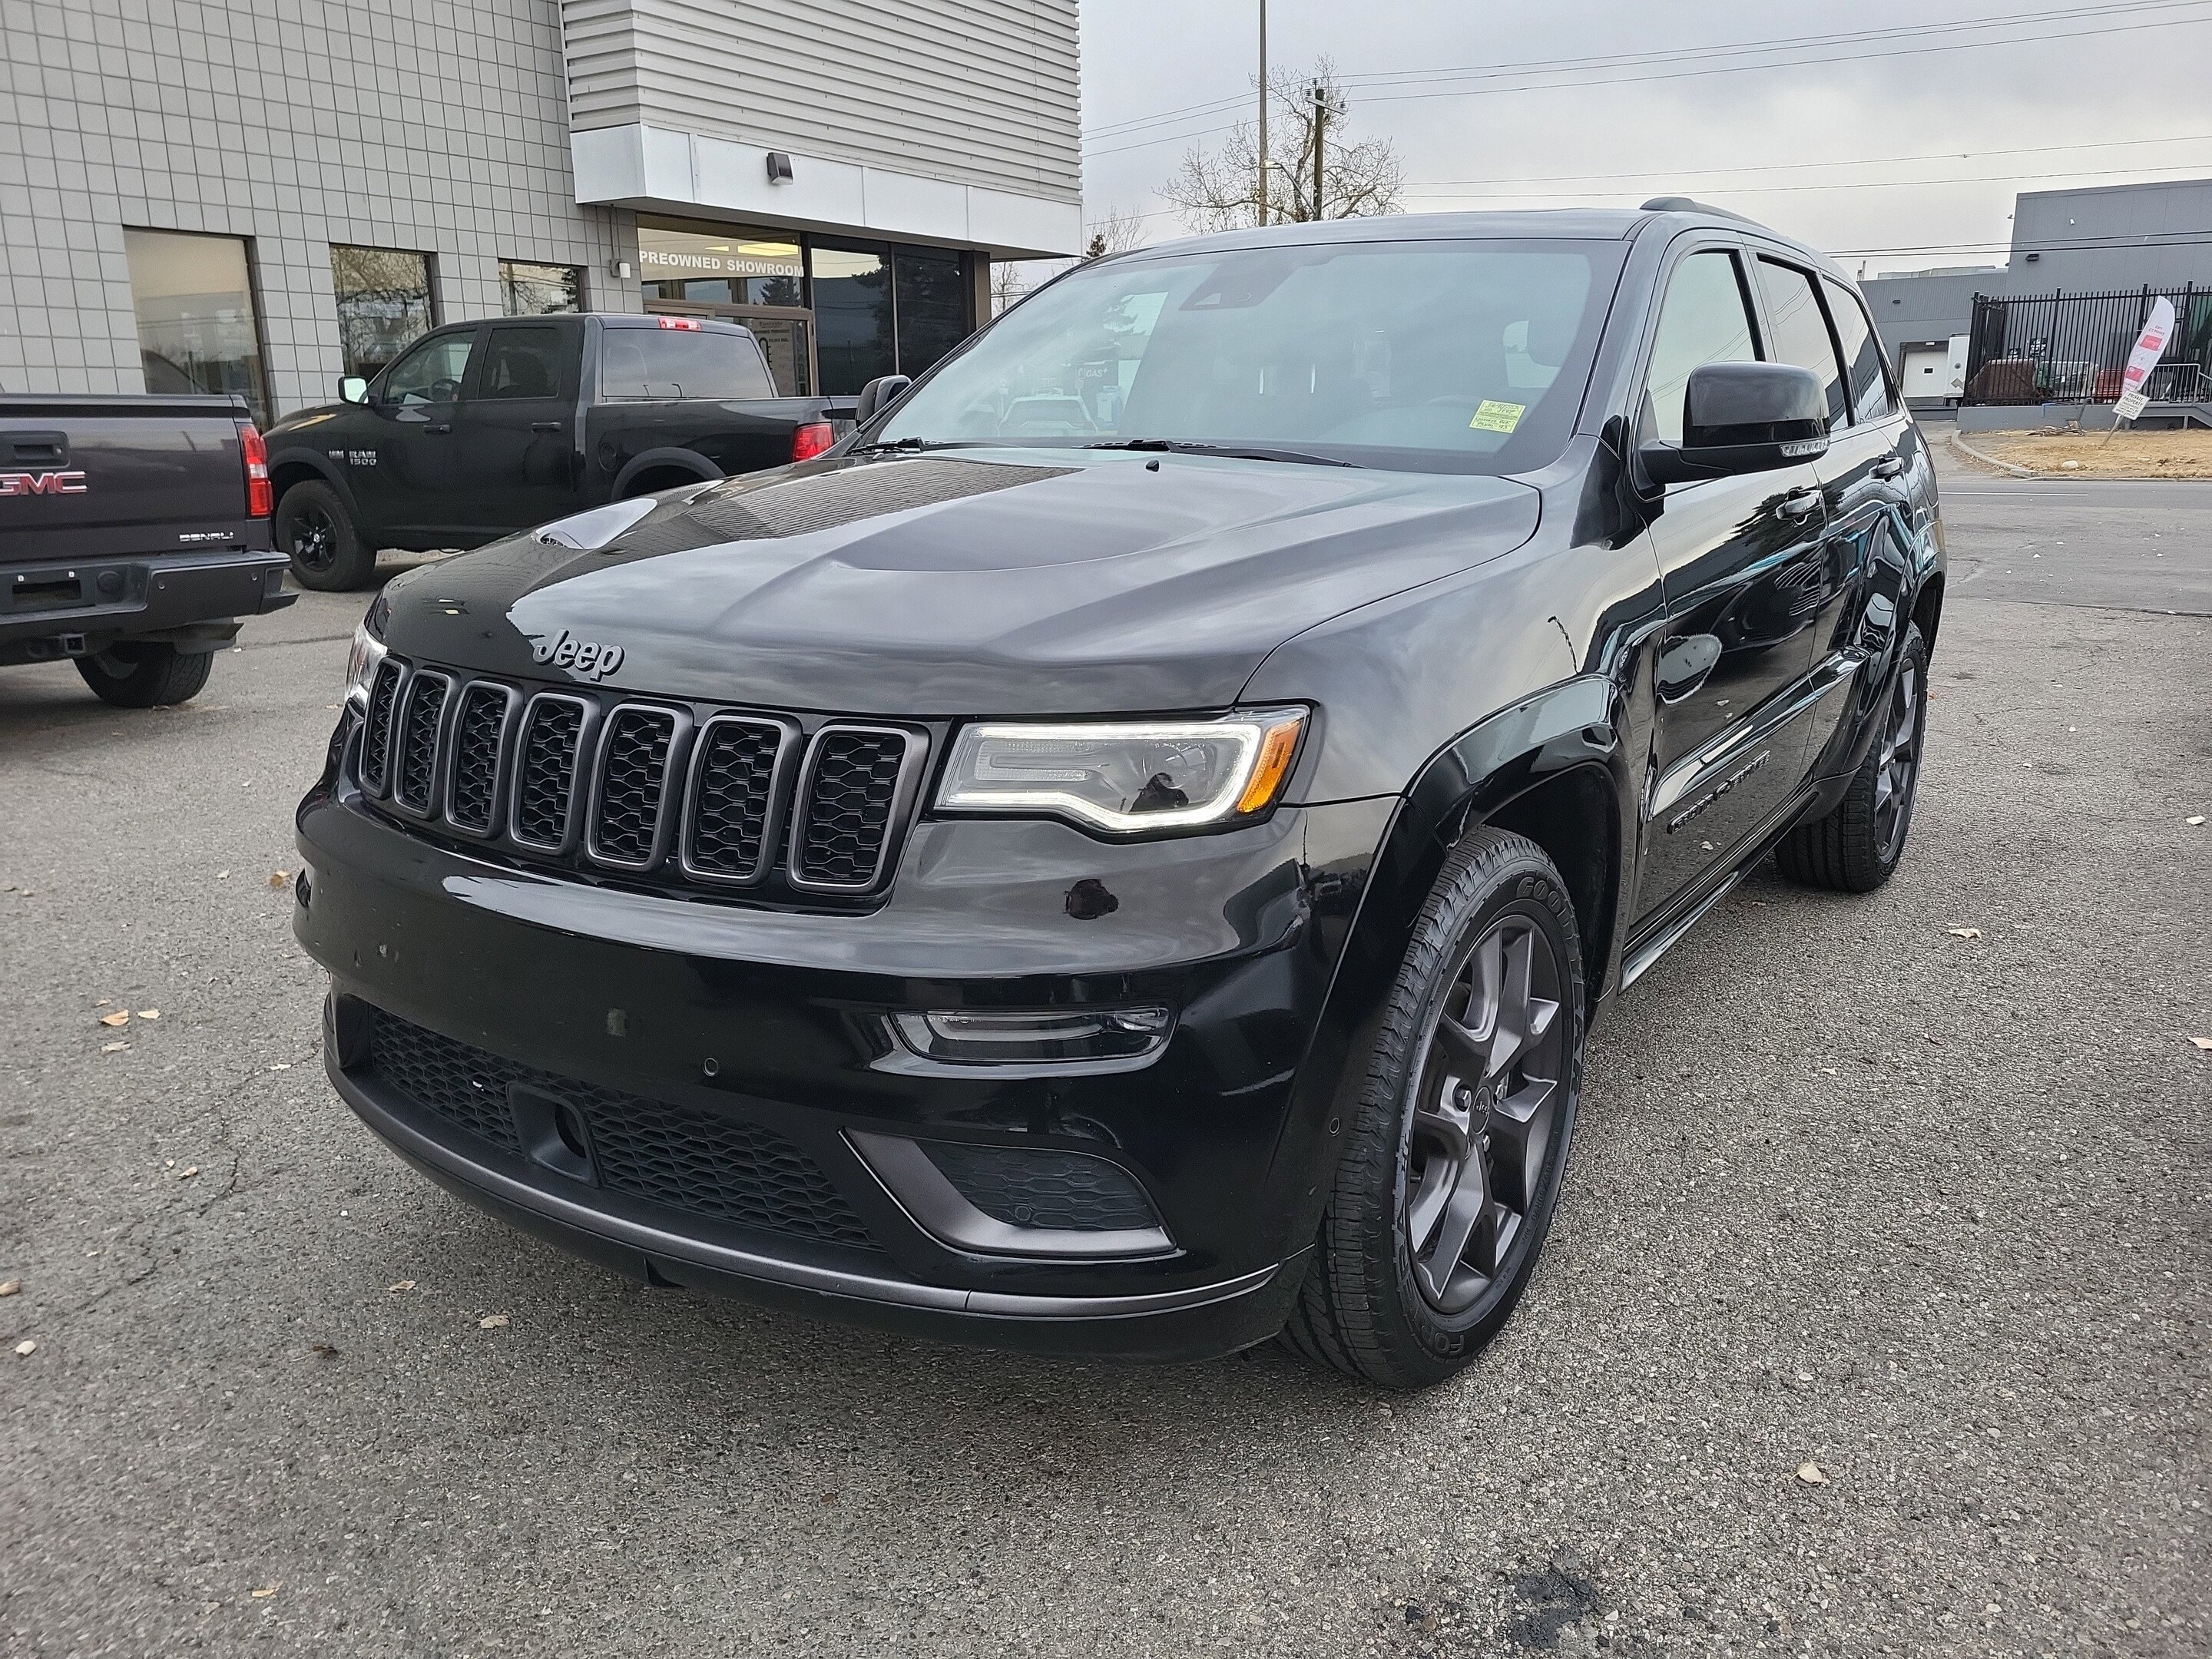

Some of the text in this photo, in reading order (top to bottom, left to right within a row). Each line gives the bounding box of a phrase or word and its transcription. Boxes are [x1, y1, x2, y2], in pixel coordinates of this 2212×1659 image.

[639, 250, 805, 277] PREOWNED SHOWROOM
[2122, 396, 2143, 406] PROPERTY
[2128, 392, 2144, 402] PRIVATE
[349, 450, 376, 459] RAM
[349, 458, 377, 466] 1500
[179, 531, 234, 542] DENALI
[532, 629, 625, 682] Jeep
